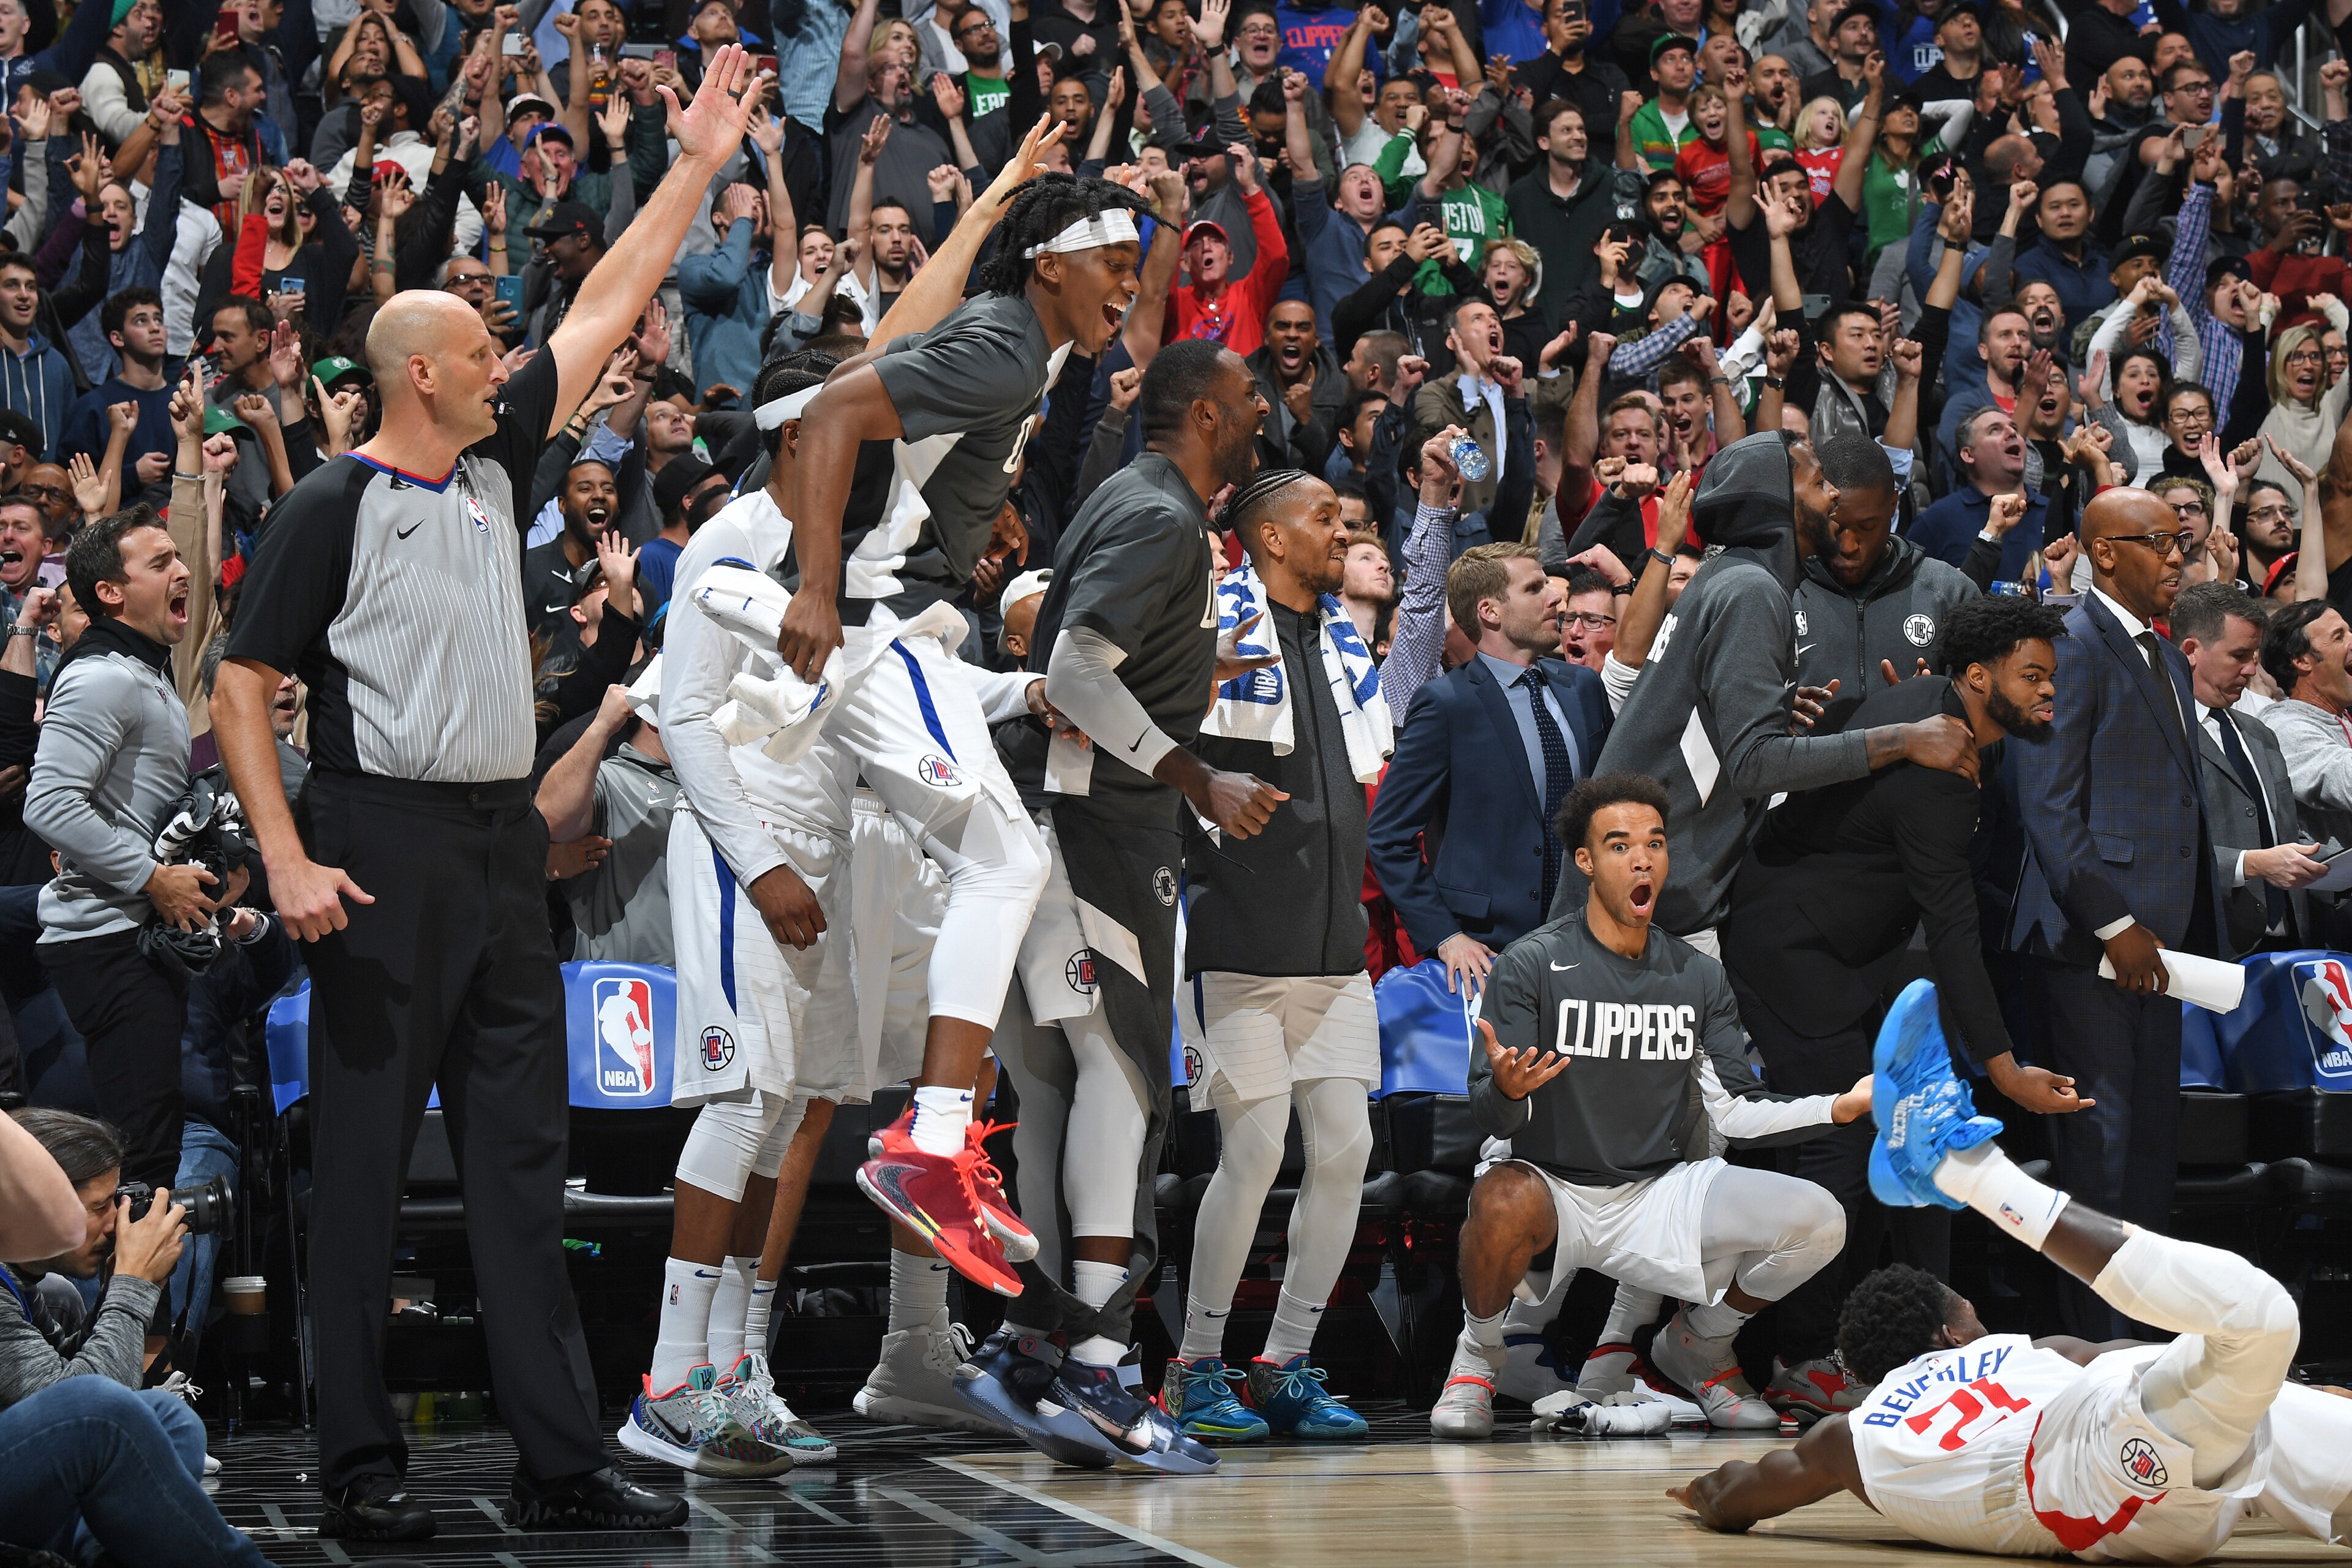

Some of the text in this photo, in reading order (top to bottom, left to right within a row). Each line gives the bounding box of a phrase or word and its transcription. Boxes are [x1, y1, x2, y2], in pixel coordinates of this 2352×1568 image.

[1556, 998, 1695, 1060] CLIPPERS
[2321, 1050, 2352, 1068] NBA
[605, 1070, 637, 1087] NBA
